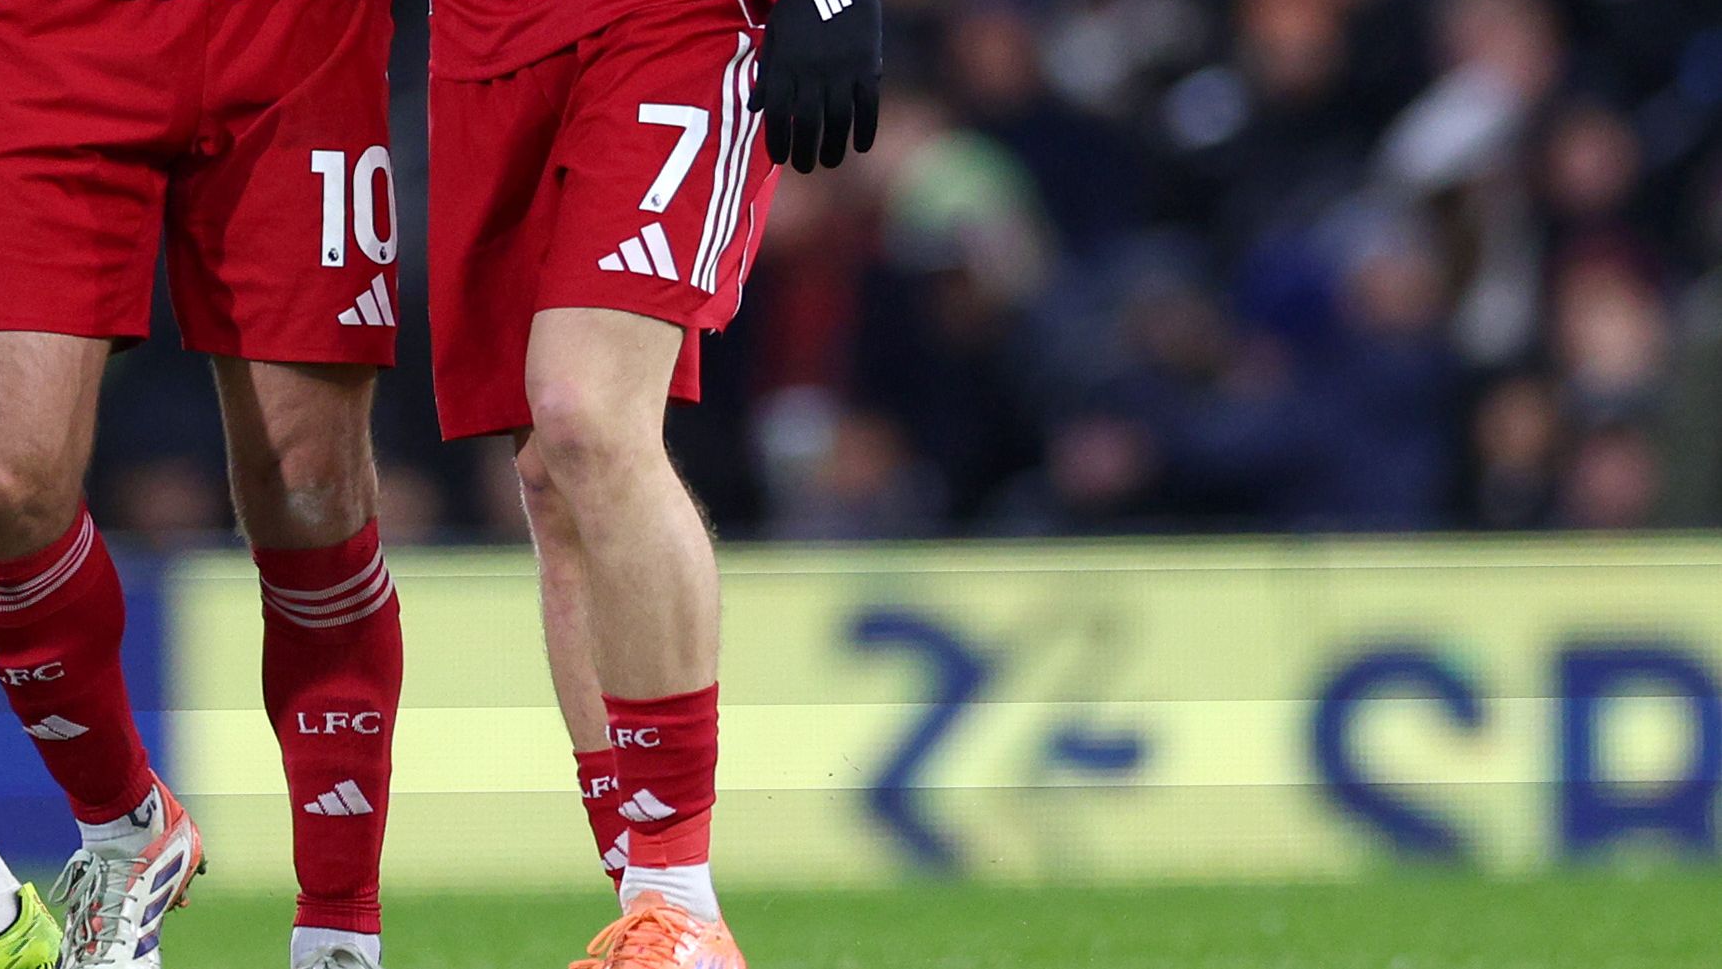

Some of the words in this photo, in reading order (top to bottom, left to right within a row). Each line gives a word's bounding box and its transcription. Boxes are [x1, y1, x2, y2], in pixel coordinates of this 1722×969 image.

[638, 103, 710, 213] 7
[311, 145, 398, 266] 10
[297, 712, 381, 734] LFC
[579, 776, 619, 798] LF
